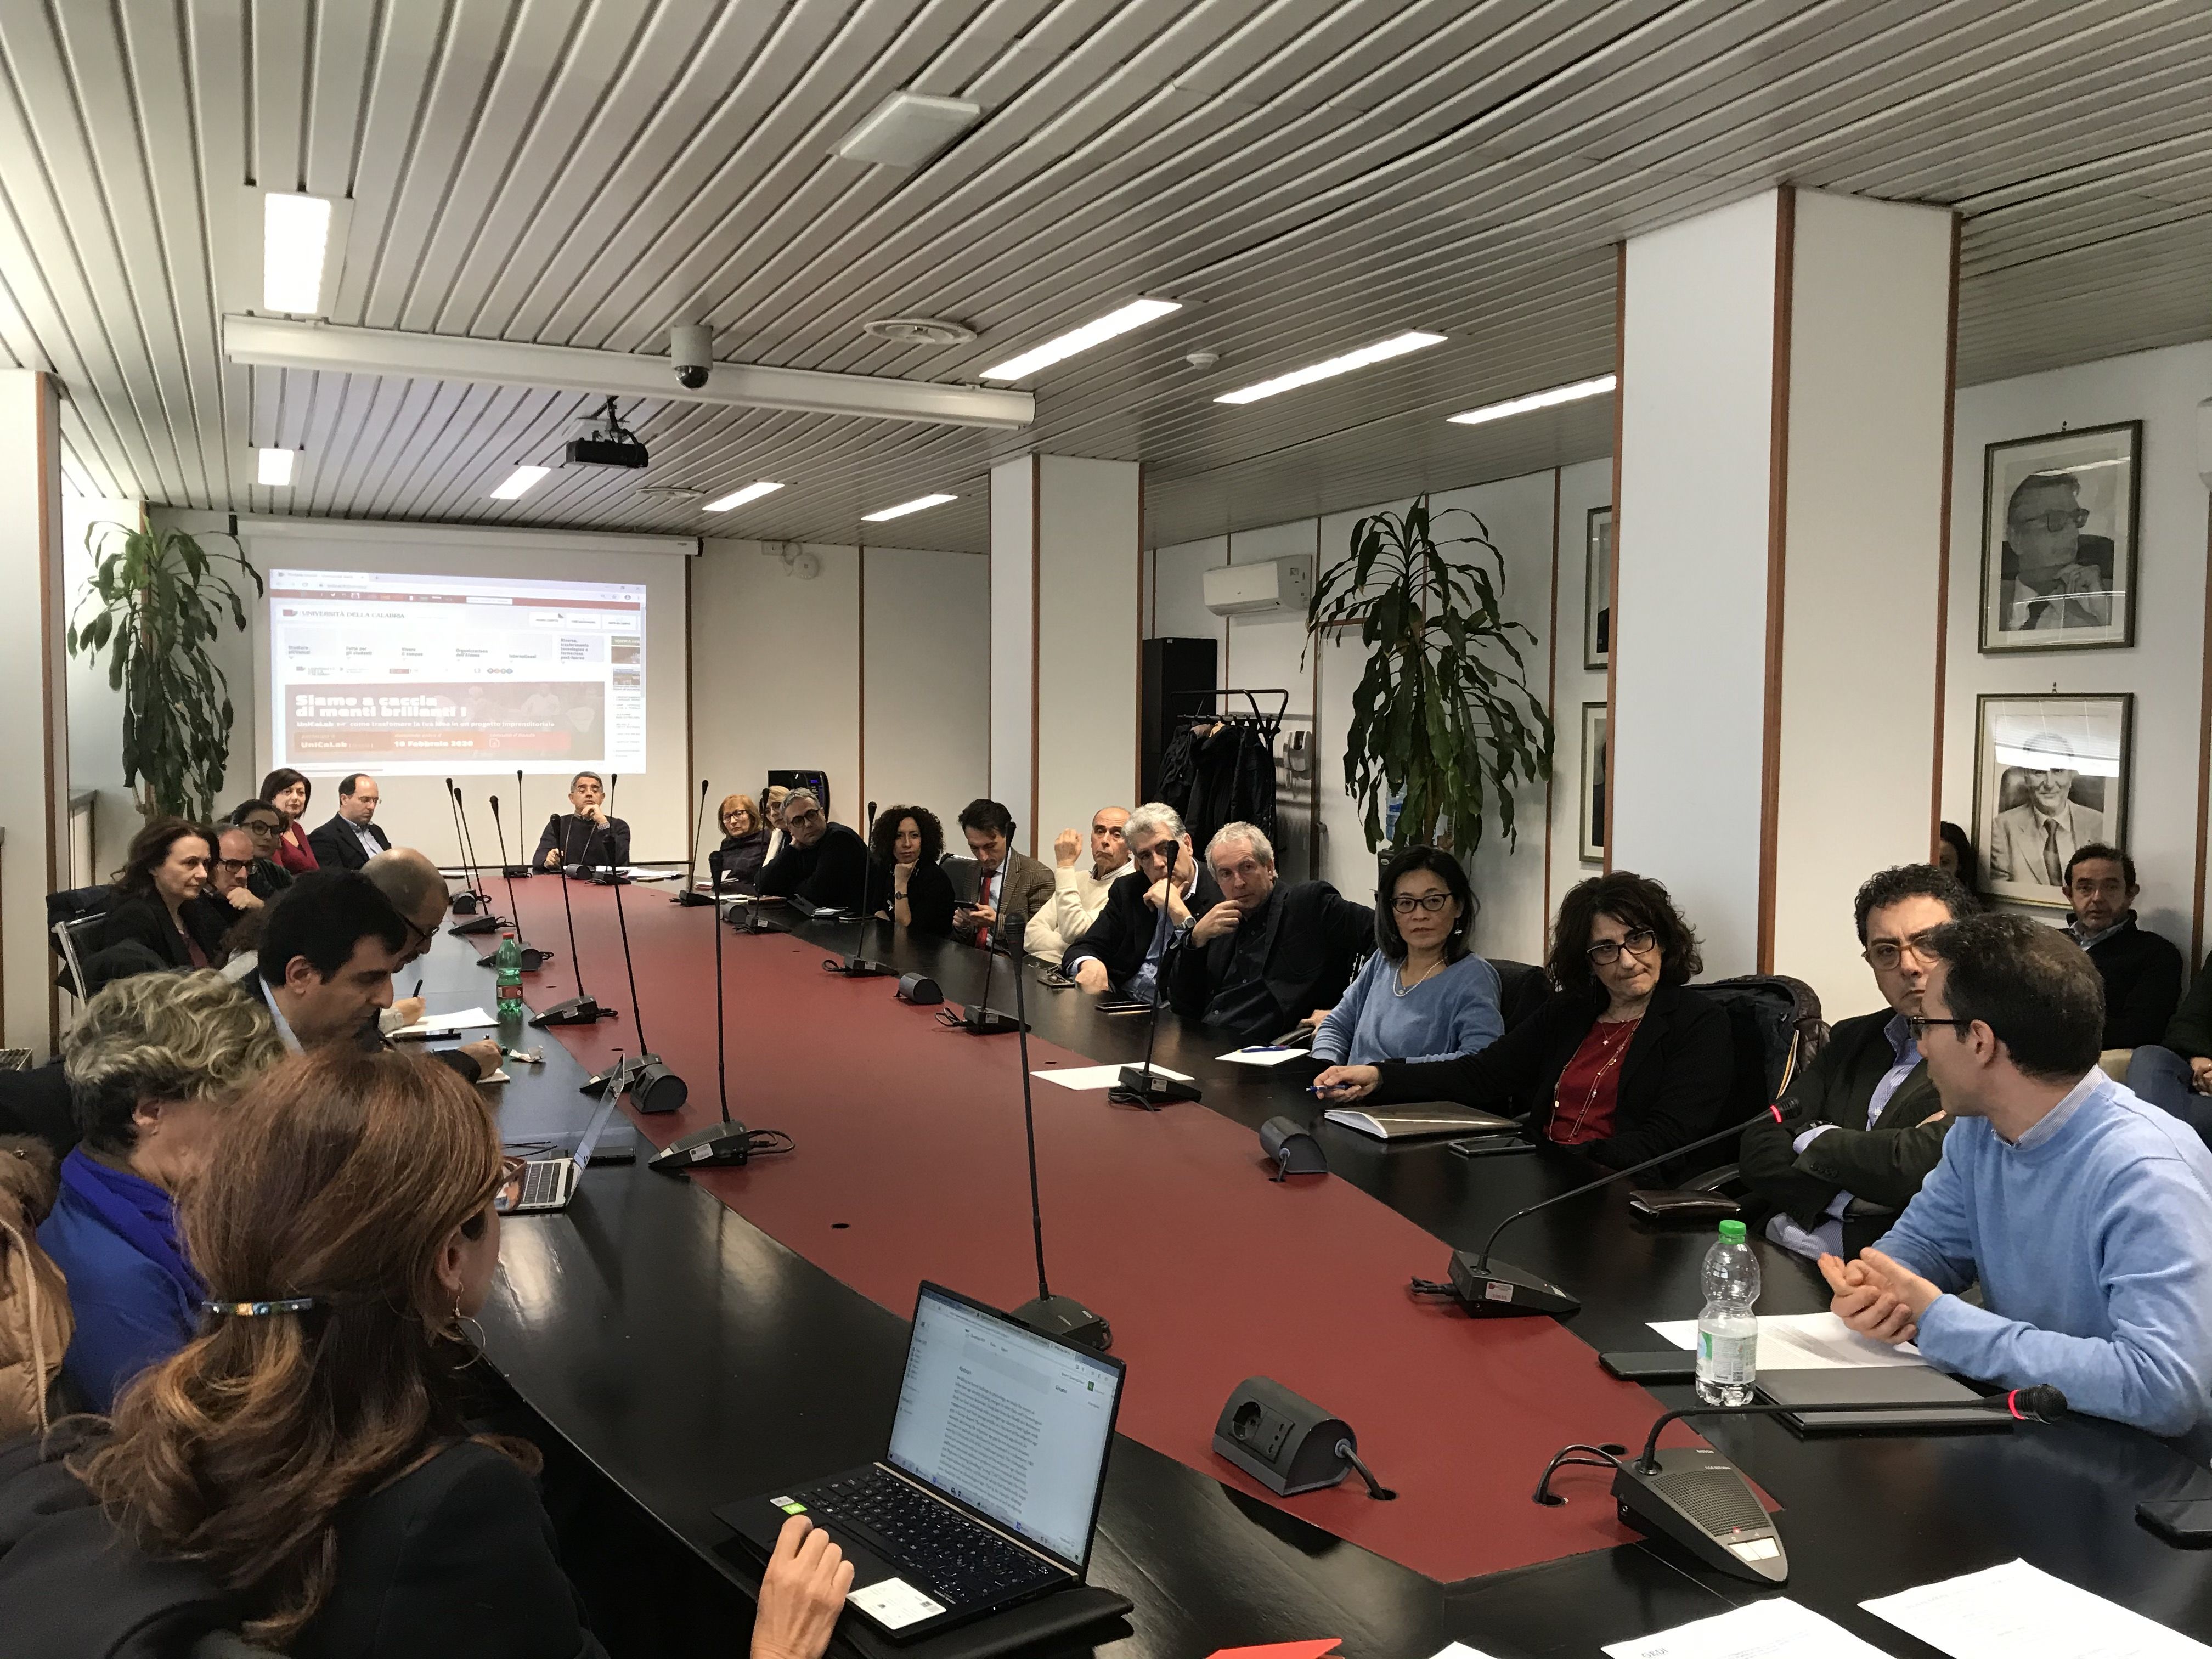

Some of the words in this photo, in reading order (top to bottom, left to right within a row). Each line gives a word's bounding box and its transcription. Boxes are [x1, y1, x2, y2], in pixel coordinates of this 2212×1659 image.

[295, 695, 357, 706] Siamo
[362, 697, 374, 706] a
[379, 695, 437, 706] caccia
[295, 706, 314, 717] di
[320, 706, 376, 717] menti
[381, 706, 456, 718] brillanti
